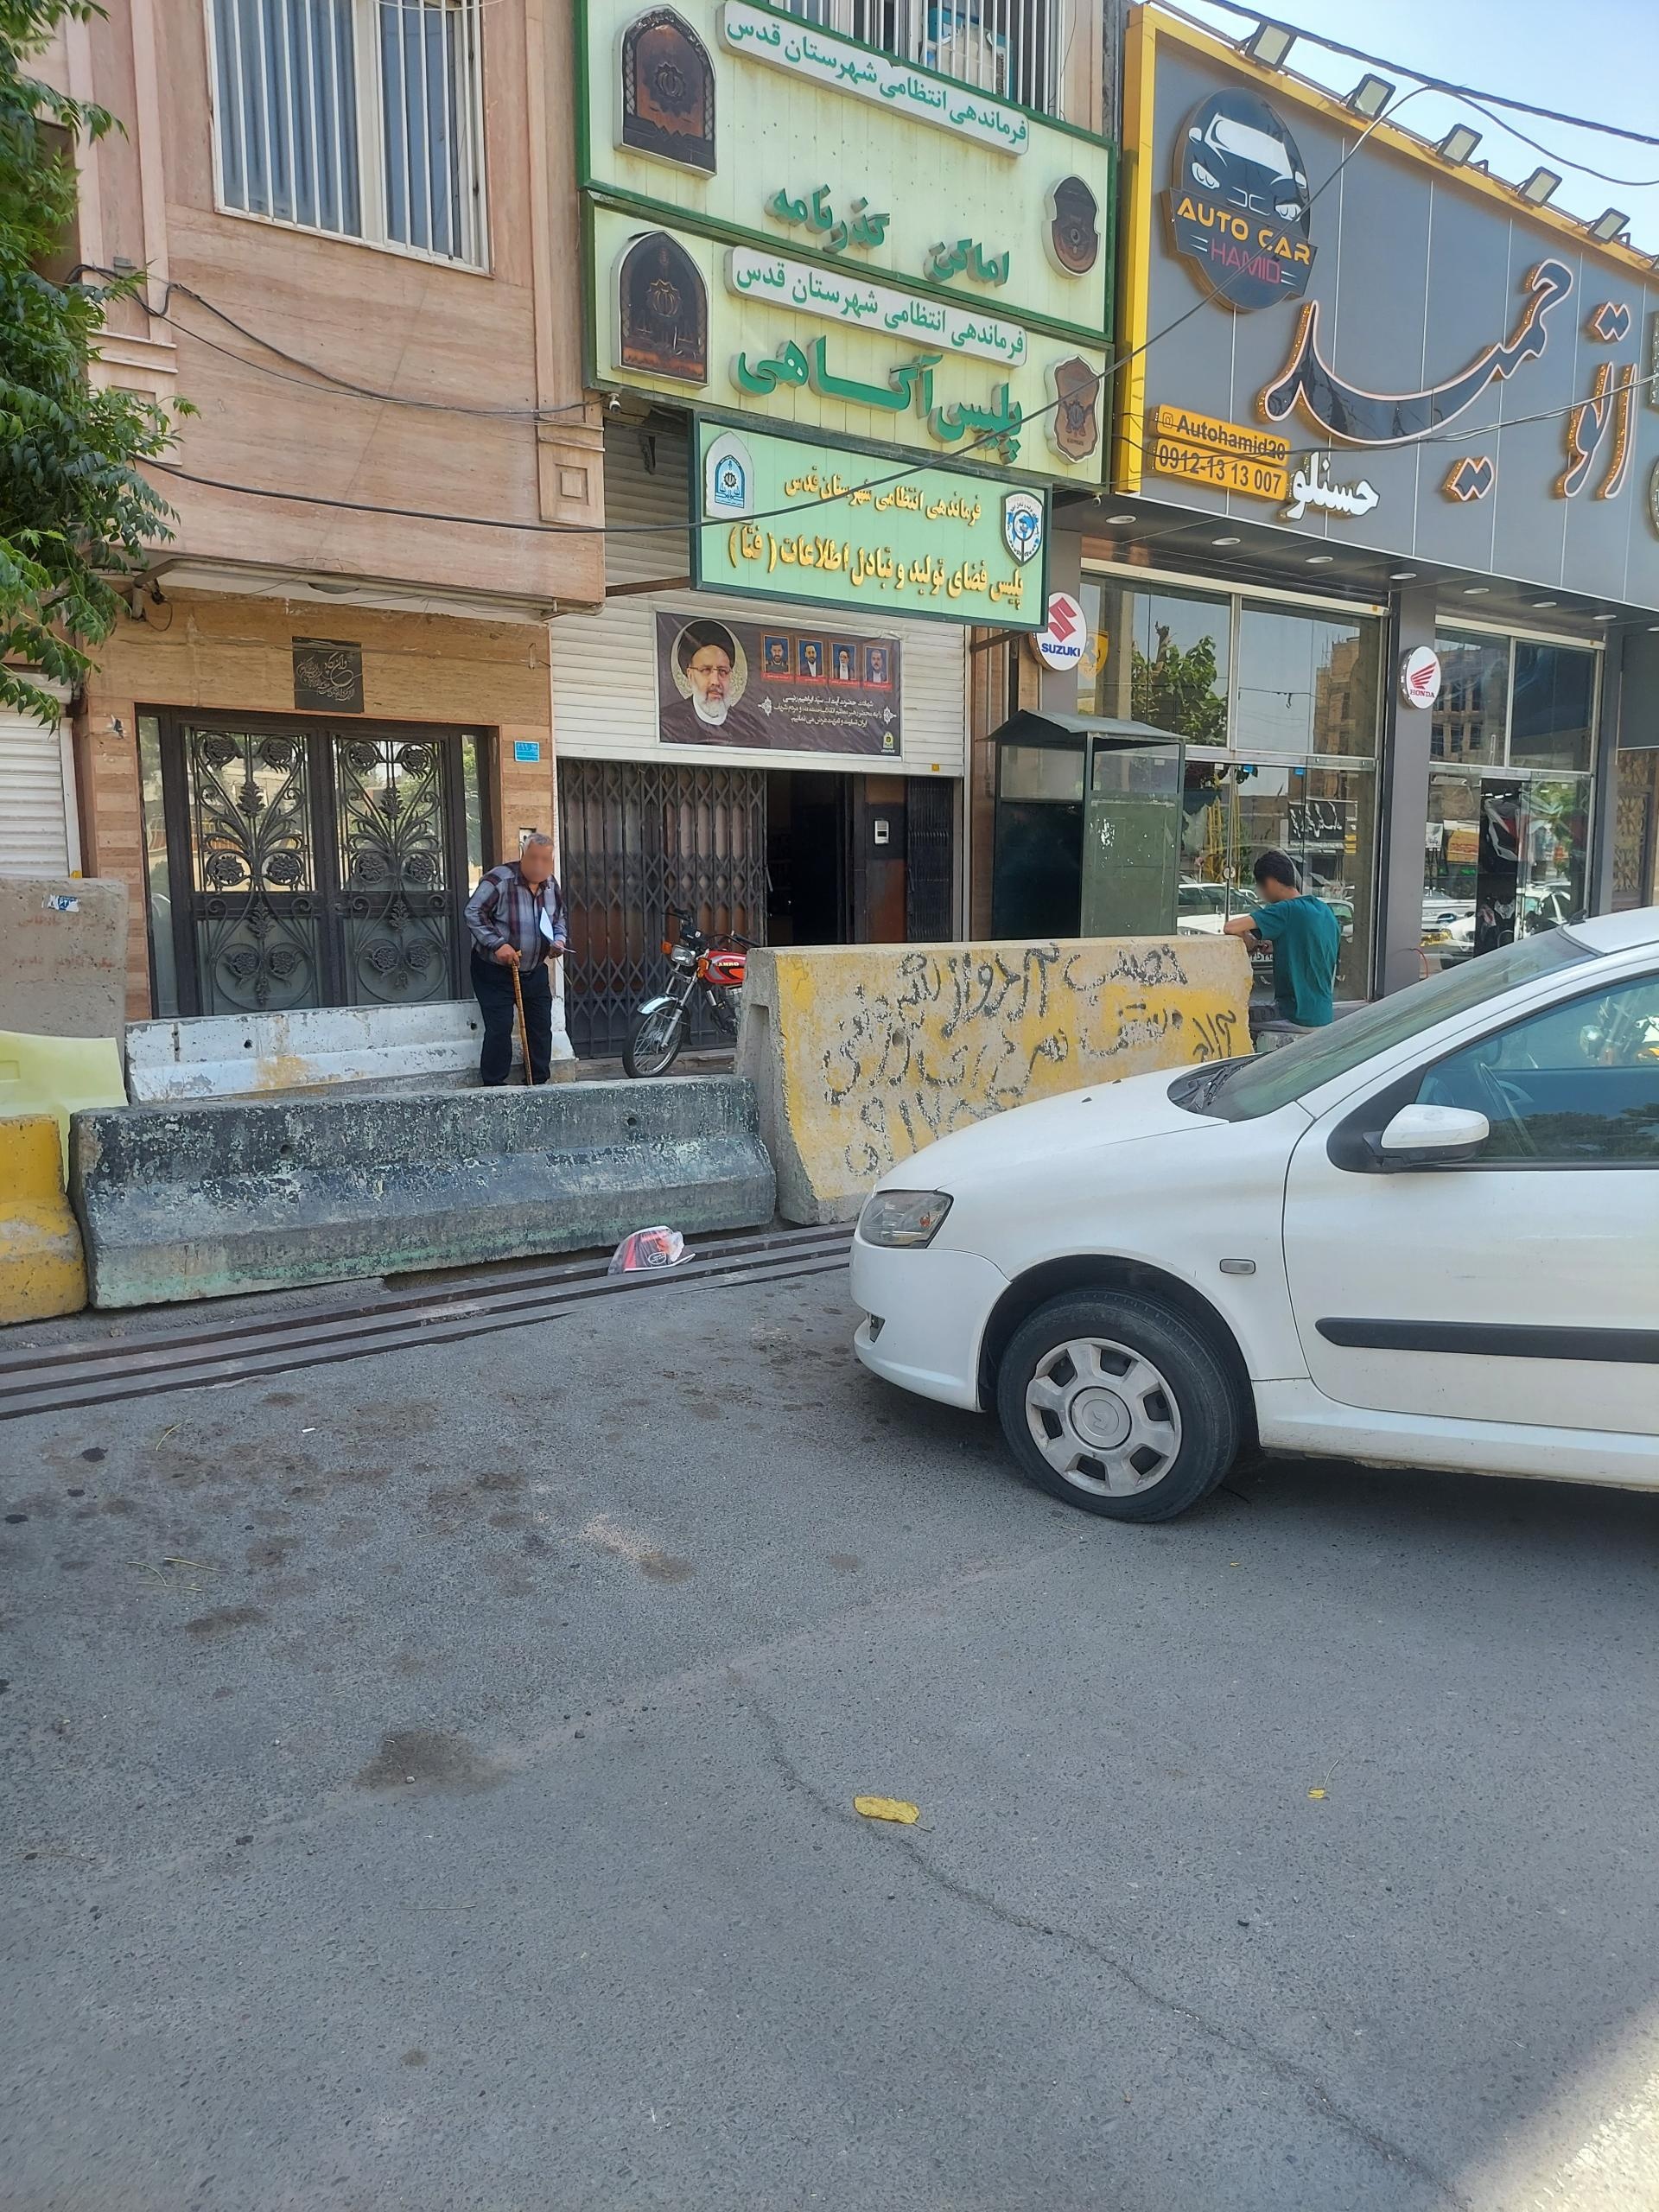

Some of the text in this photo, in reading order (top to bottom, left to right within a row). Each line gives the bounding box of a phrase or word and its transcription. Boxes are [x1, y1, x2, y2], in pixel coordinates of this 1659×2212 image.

[727, 23, 1027, 143] فرماندهی انتظامی شهرستان قدس
[767, 183, 1010, 286] اماکن گذرنامه
[1177, 197, 1311, 264] AUTO CAR
[1211, 238, 1281, 284] HAMID
[736, 262, 1023, 359] فرماندهی انتظامی شهرستان قدس
[735, 335, 1022, 464] پلیس آگاهی
[1176, 415, 1286, 461] Autohamid20
[785, 465, 819, 496] قدس
[874, 486, 924, 511] انتظامی
[1231, 462, 1249, 486] 13
[1254, 469, 1282, 494] 007
[1286, 451, 1381, 520] حسنلو
[926, 491, 982, 526] فرماندهی
[780, 533, 849, 571] اطلاعات
[850, 547, 893, 588] تبادل
[895, 563, 905, 589] و
[908, 554, 944, 595] تولید
[947, 560, 988, 598] فضای
[990, 568, 1024, 610] پلیس
[1041, 643, 1081, 657] SUZUKI
[1410, 690, 1434, 698] HONDA
